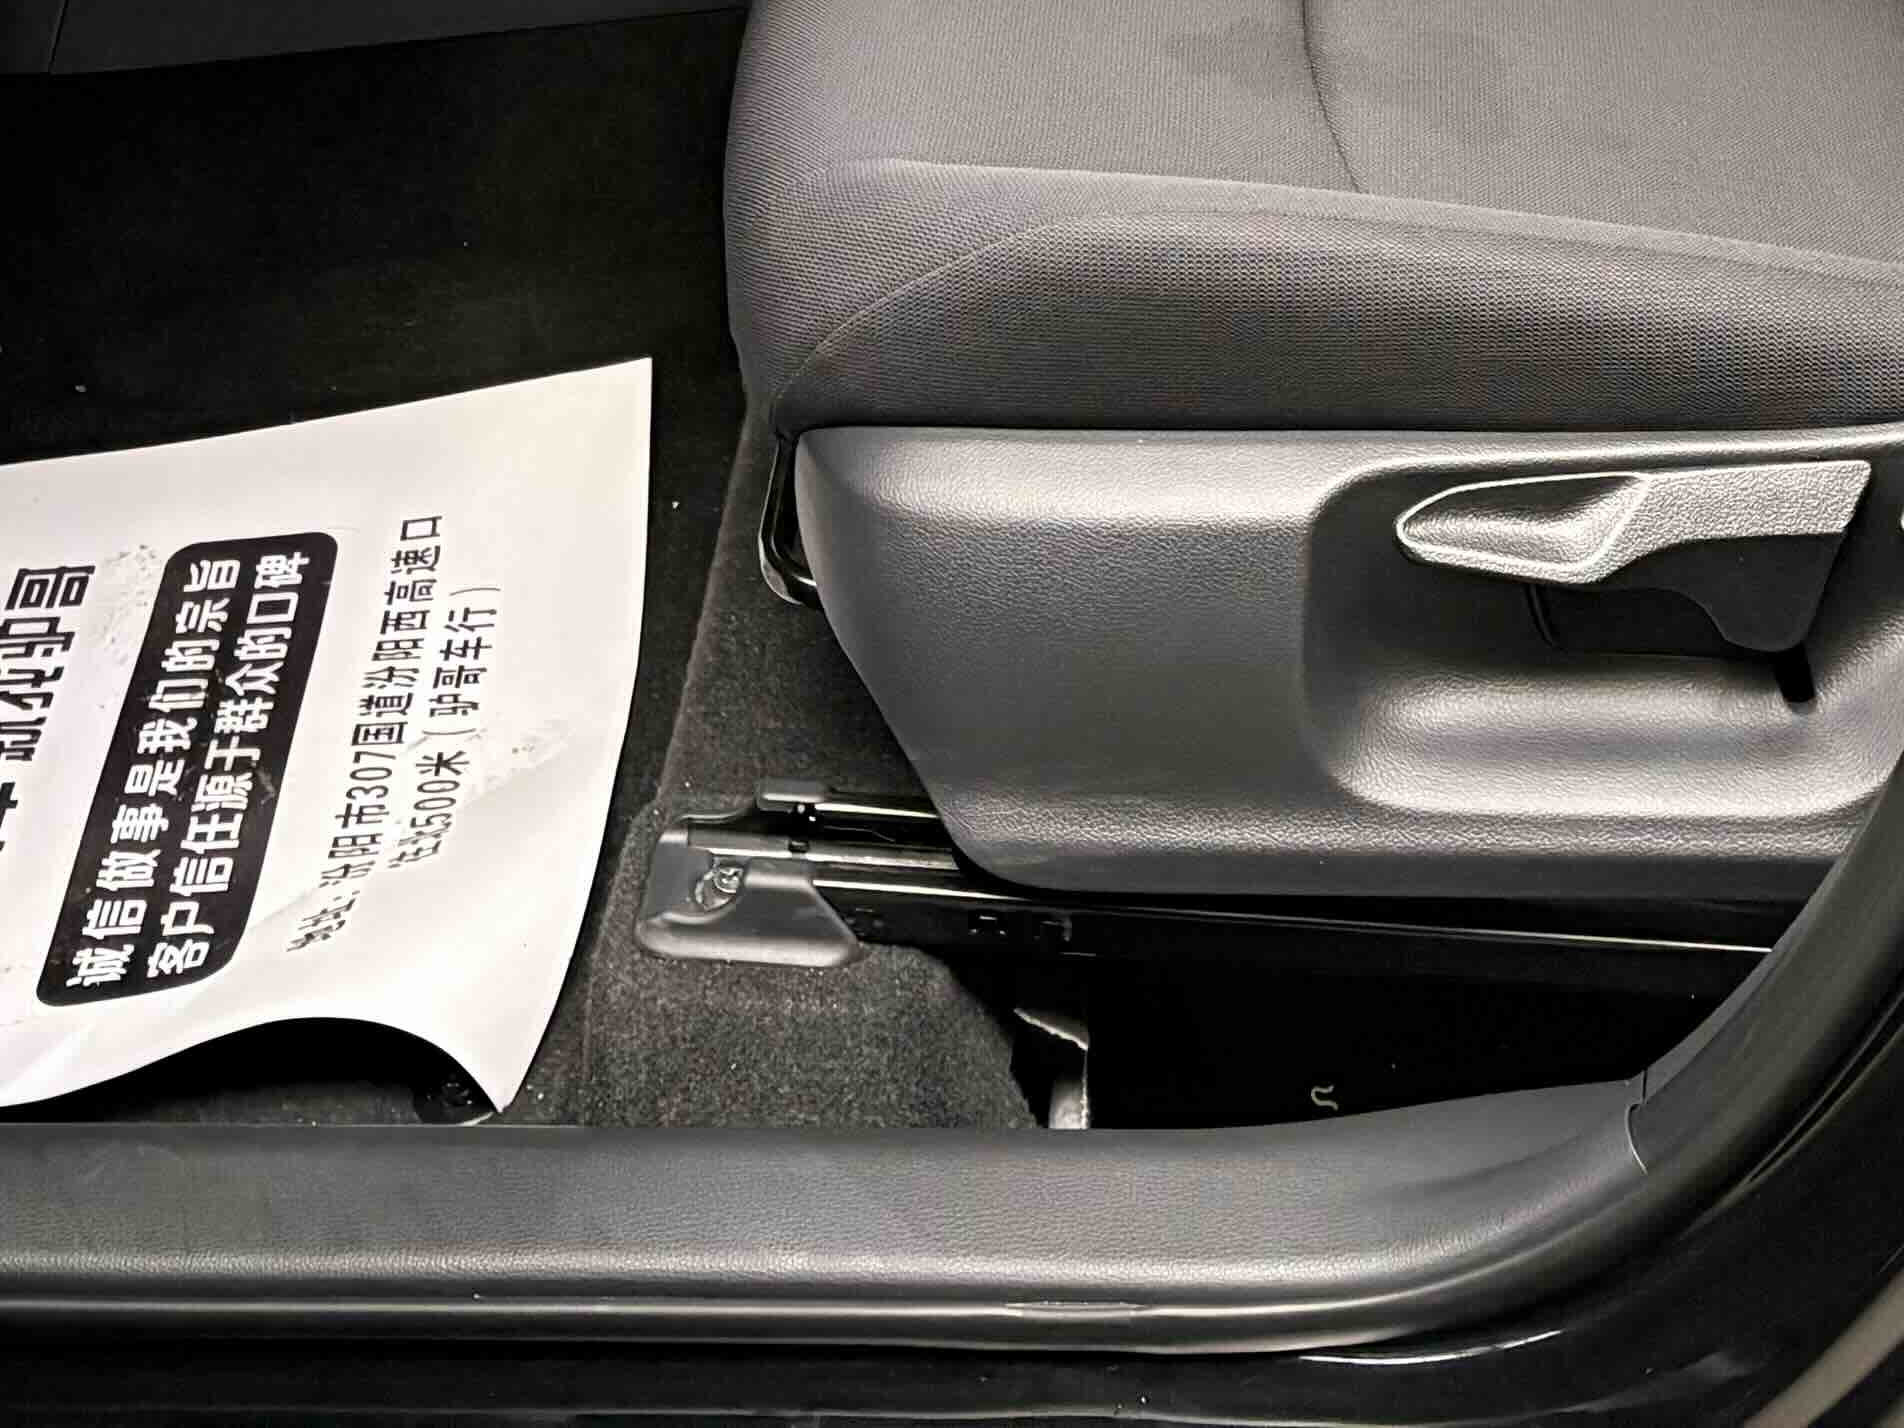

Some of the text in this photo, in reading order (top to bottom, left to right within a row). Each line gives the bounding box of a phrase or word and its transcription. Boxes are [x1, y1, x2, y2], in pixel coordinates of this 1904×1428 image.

[66, 558, 242, 988] 诚信做事是我们的宗旨
[146, 550, 311, 979] 客户信任源于群众的口碑
